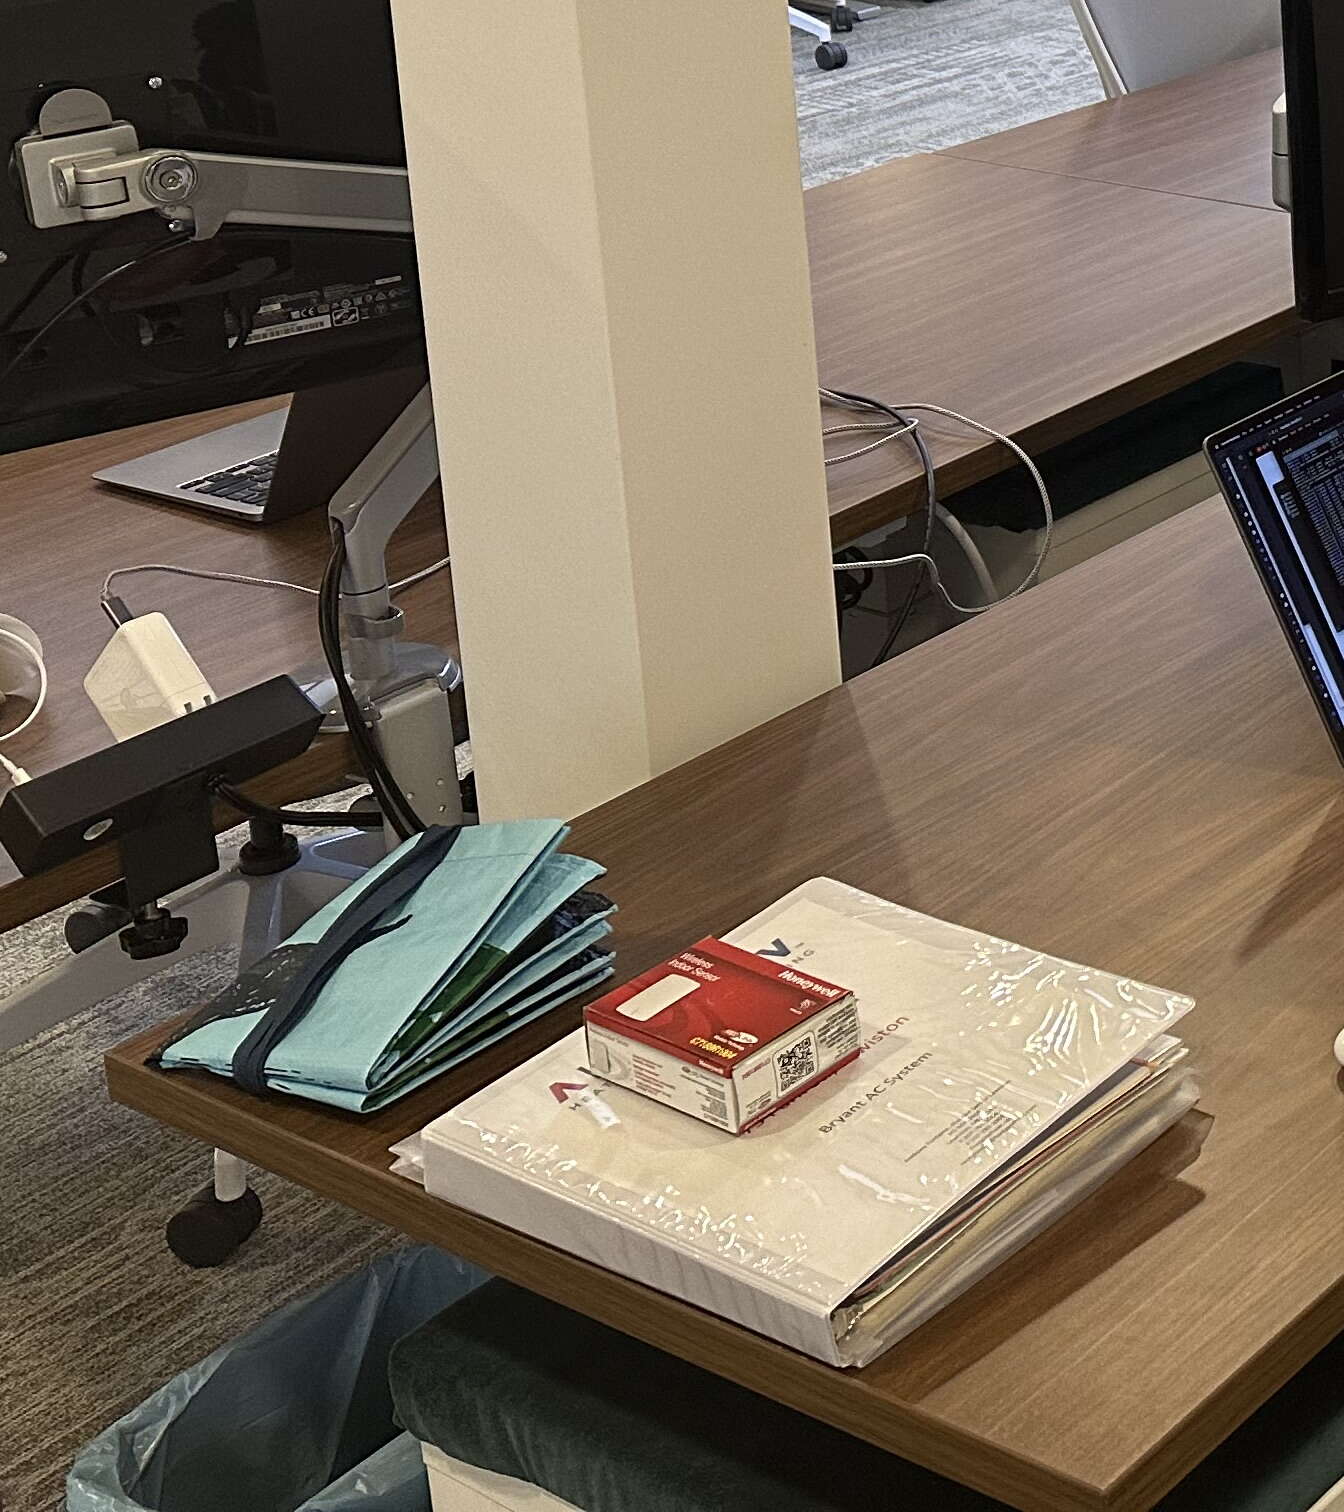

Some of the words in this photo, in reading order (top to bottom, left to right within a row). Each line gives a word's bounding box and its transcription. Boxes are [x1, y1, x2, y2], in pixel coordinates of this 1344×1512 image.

[667, 959, 694, 973] Indoor
[691, 966, 721, 982] Sensor
[679, 952, 715, 969] Wireless
[778, 970, 841, 998] Honeywell
[818, 1100, 868, 1133] Bryant
[865, 1084, 887, 1101] AC
[883, 1051, 933, 1086] System
